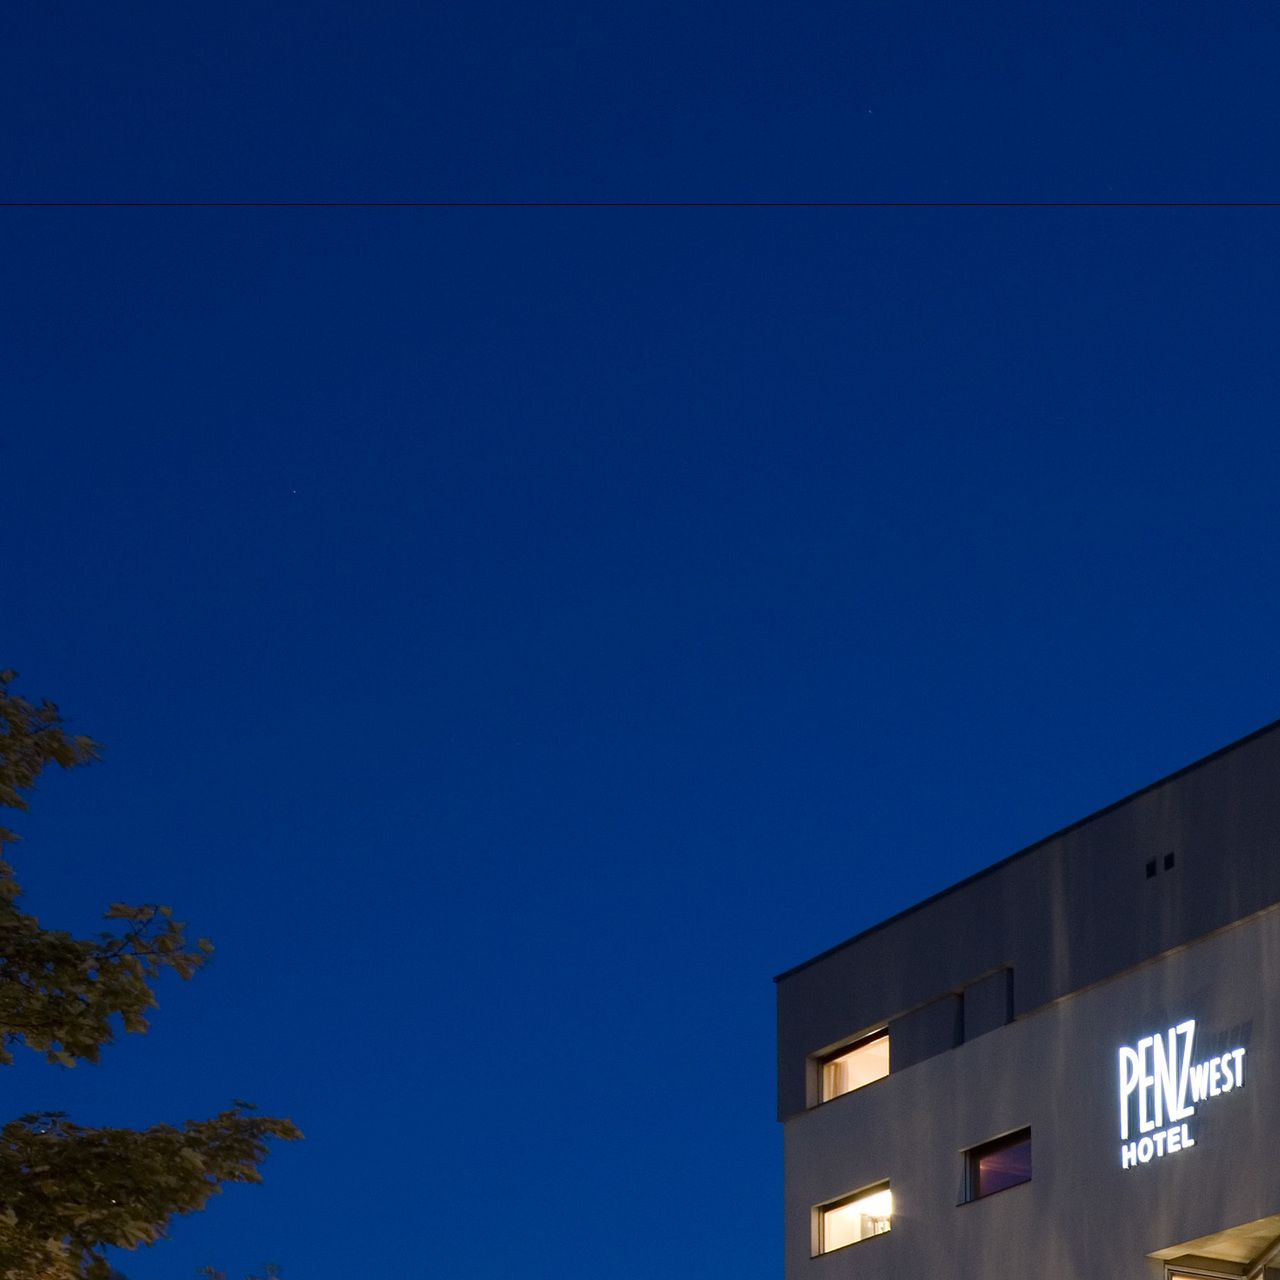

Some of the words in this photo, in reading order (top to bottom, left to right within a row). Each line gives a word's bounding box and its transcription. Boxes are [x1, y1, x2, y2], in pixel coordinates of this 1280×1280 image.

[1119, 1019, 1196, 1140] PENZ
[1190, 1047, 1246, 1103] WEST
[1121, 1123, 1195, 1169] HOTEL
